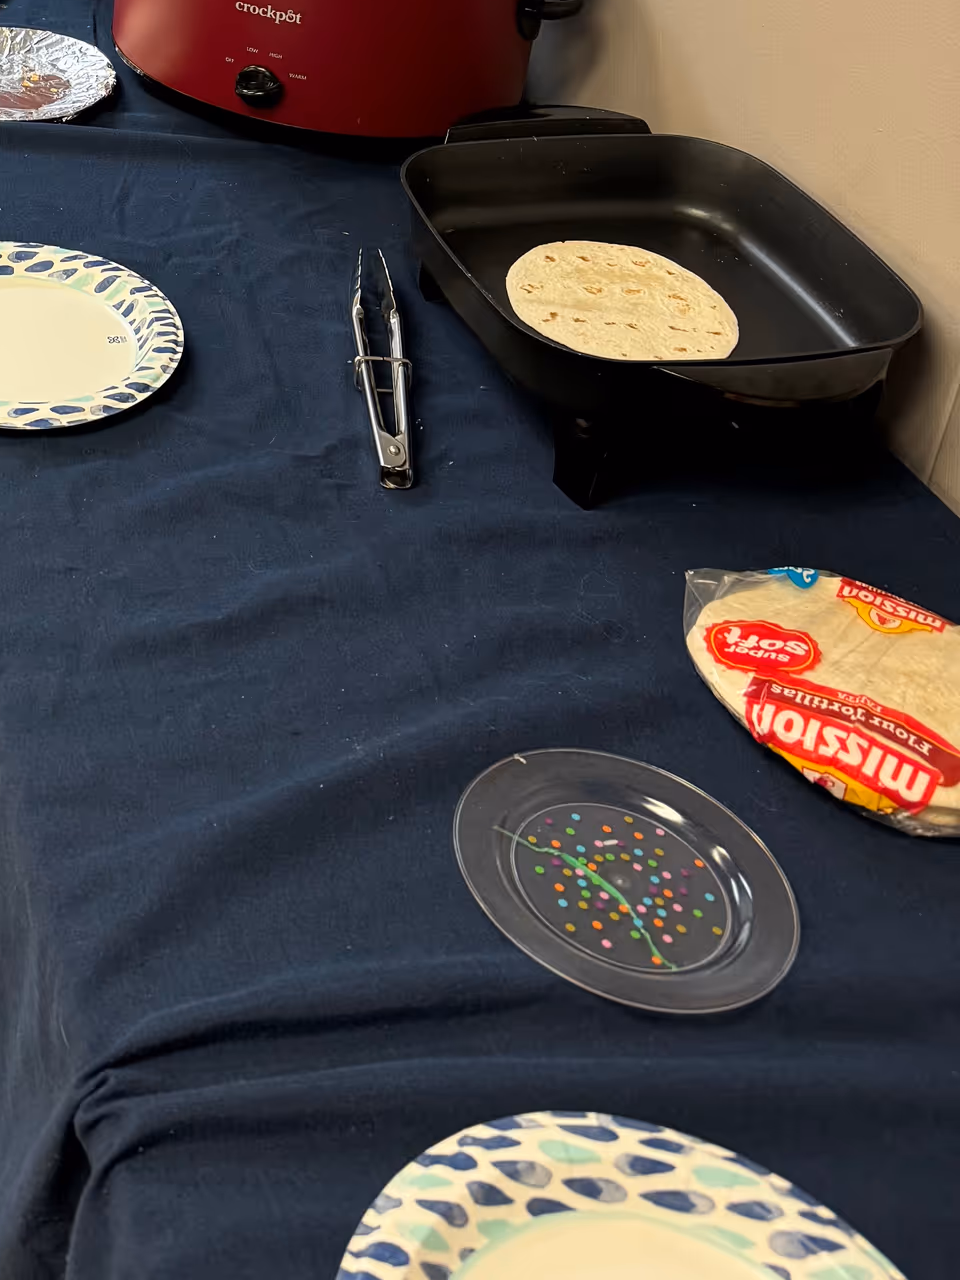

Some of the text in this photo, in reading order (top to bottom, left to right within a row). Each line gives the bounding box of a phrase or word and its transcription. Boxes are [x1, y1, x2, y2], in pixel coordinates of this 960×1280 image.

[235, 0, 302, 25] crockpot
[724, 645, 791, 662] super
[771, 683, 933, 756] Flour Tortillas
